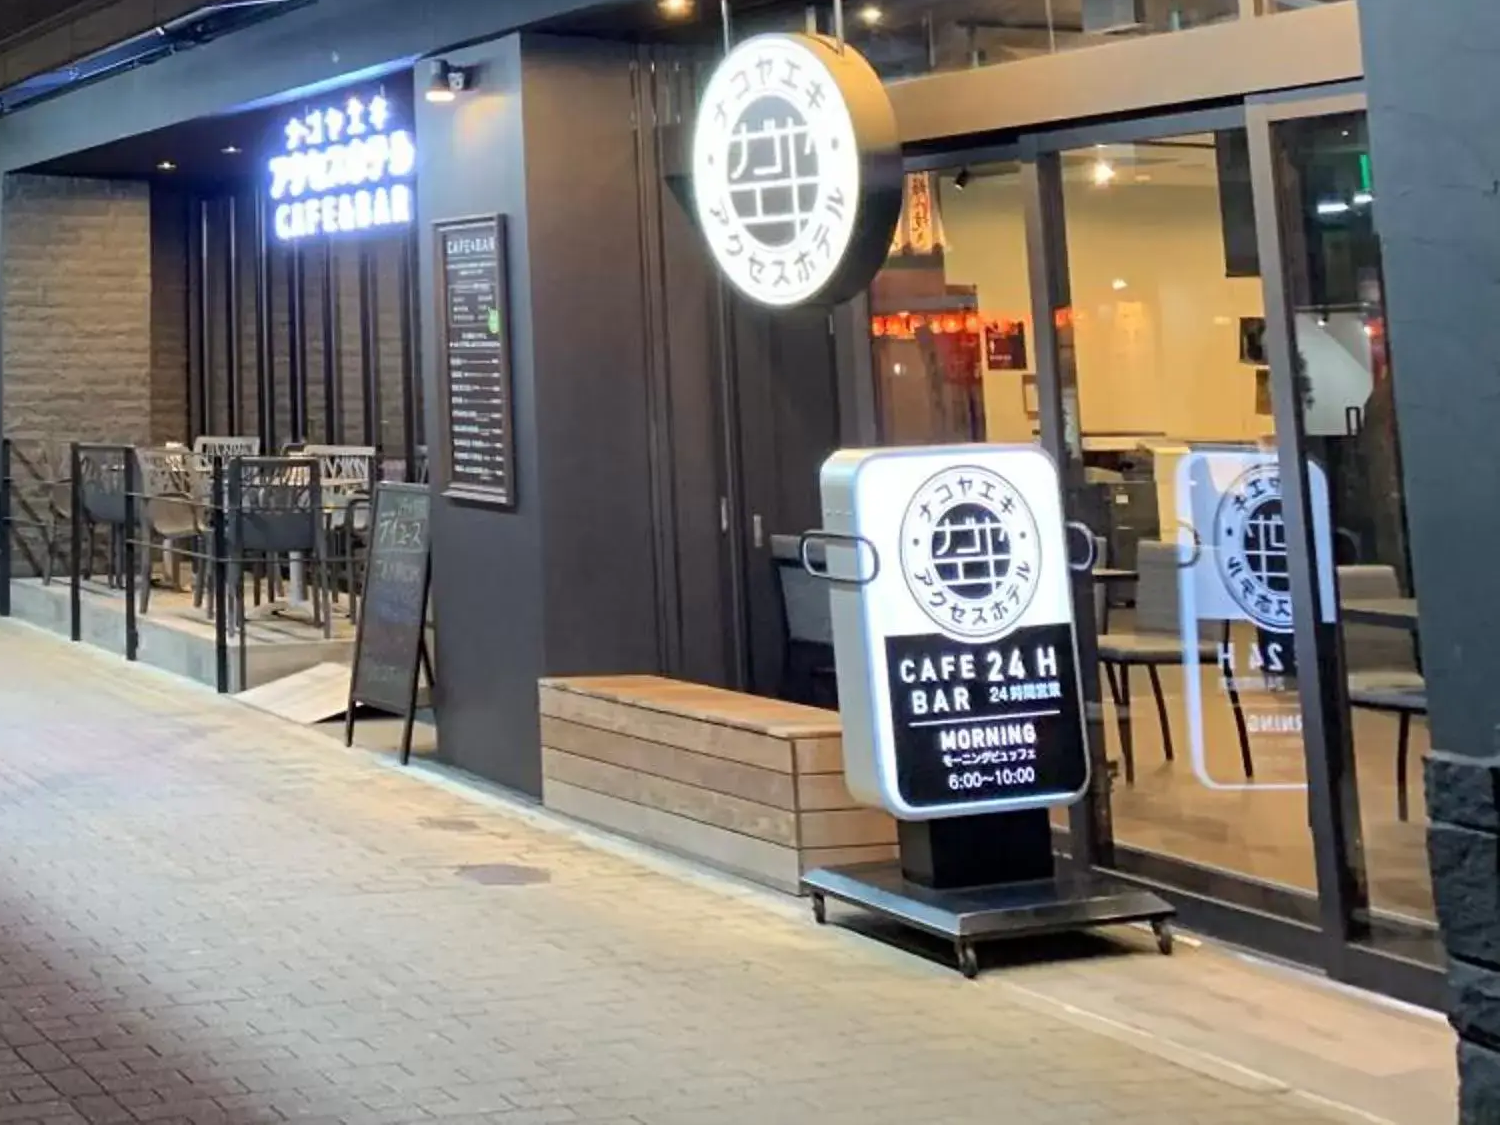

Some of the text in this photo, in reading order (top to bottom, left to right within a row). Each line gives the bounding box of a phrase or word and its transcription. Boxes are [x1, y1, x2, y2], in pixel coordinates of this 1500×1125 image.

[914, 561, 1031, 626] アクセスホテル
[900, 654, 976, 684] CAFE
[911, 687, 971, 715] BAR
[940, 723, 1038, 751] MORNING
[942, 748, 1037, 767] モーニングビュッフェ
